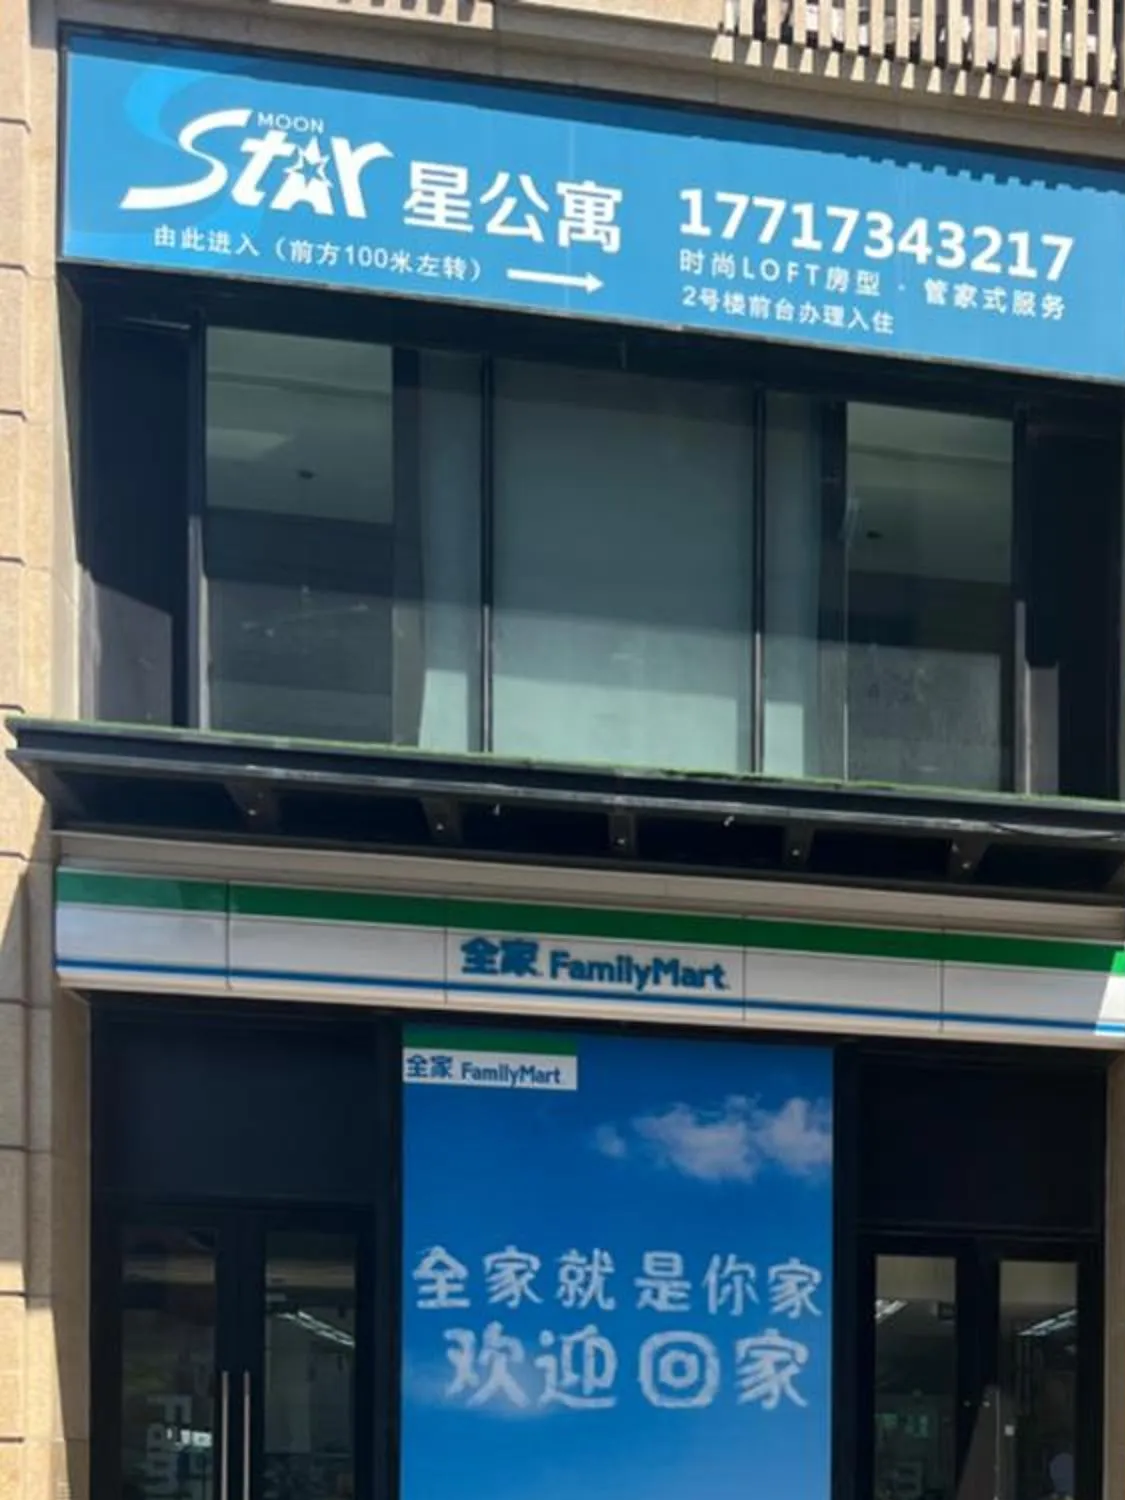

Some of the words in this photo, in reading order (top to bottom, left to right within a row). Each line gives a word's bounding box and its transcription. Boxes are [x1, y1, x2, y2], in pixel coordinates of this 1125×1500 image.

[257, 111, 325, 133] MOON
[403, 160, 622, 254] 星公寓
[679, 188, 1075, 282] 17717343217
[682, 284, 895, 335] 2号楼前台办理入住
[460, 936, 540, 977] 全家
[550, 950, 727, 991] FamilyMart
[406, 1053, 454, 1080] 全家
[460, 1062, 561, 1088] FamilyMart
[412, 1245, 823, 1319] 全家就是你家
[443, 1321, 810, 1410] 欢迎回家
